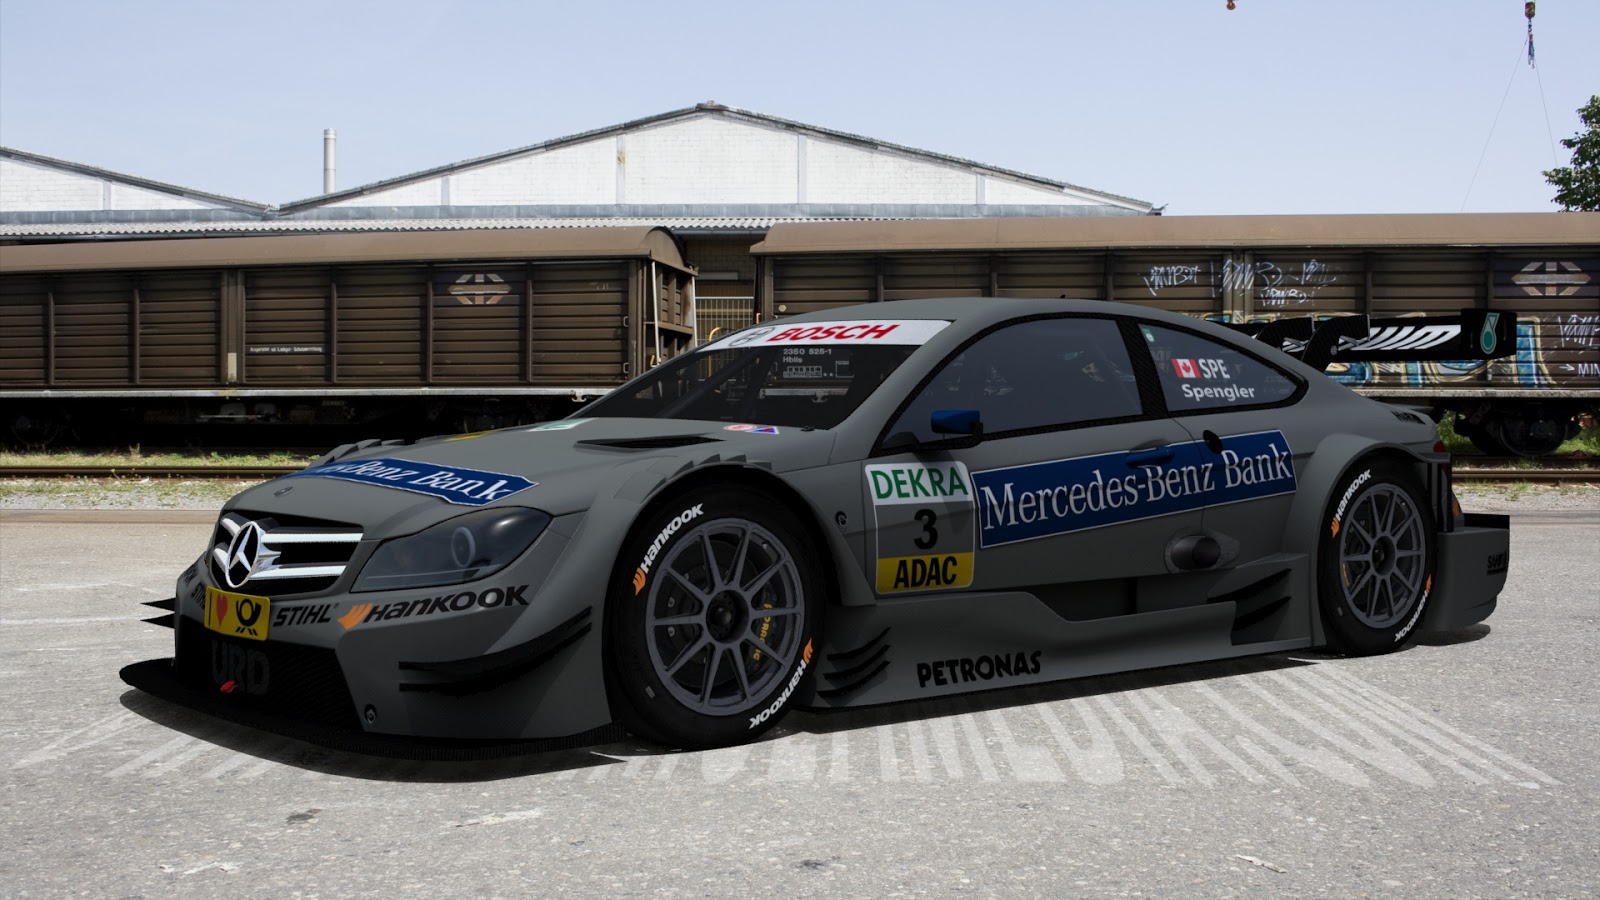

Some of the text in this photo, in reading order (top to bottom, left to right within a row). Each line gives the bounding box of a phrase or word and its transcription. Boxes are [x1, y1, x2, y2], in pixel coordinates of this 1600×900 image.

[767, 324, 899, 342] BOSCH
[1198, 358, 1230, 379] SPE
[1181, 383, 1255, 402] Spengler
[407, 471, 514, 500] Bank
[870, 466, 969, 499] DEKRA
[980, 442, 1294, 531] Mercedes-Benz Bank
[913, 509, 938, 550] 3
[893, 555, 958, 590] ADAC
[917, 650, 1042, 687] PETRONAS
